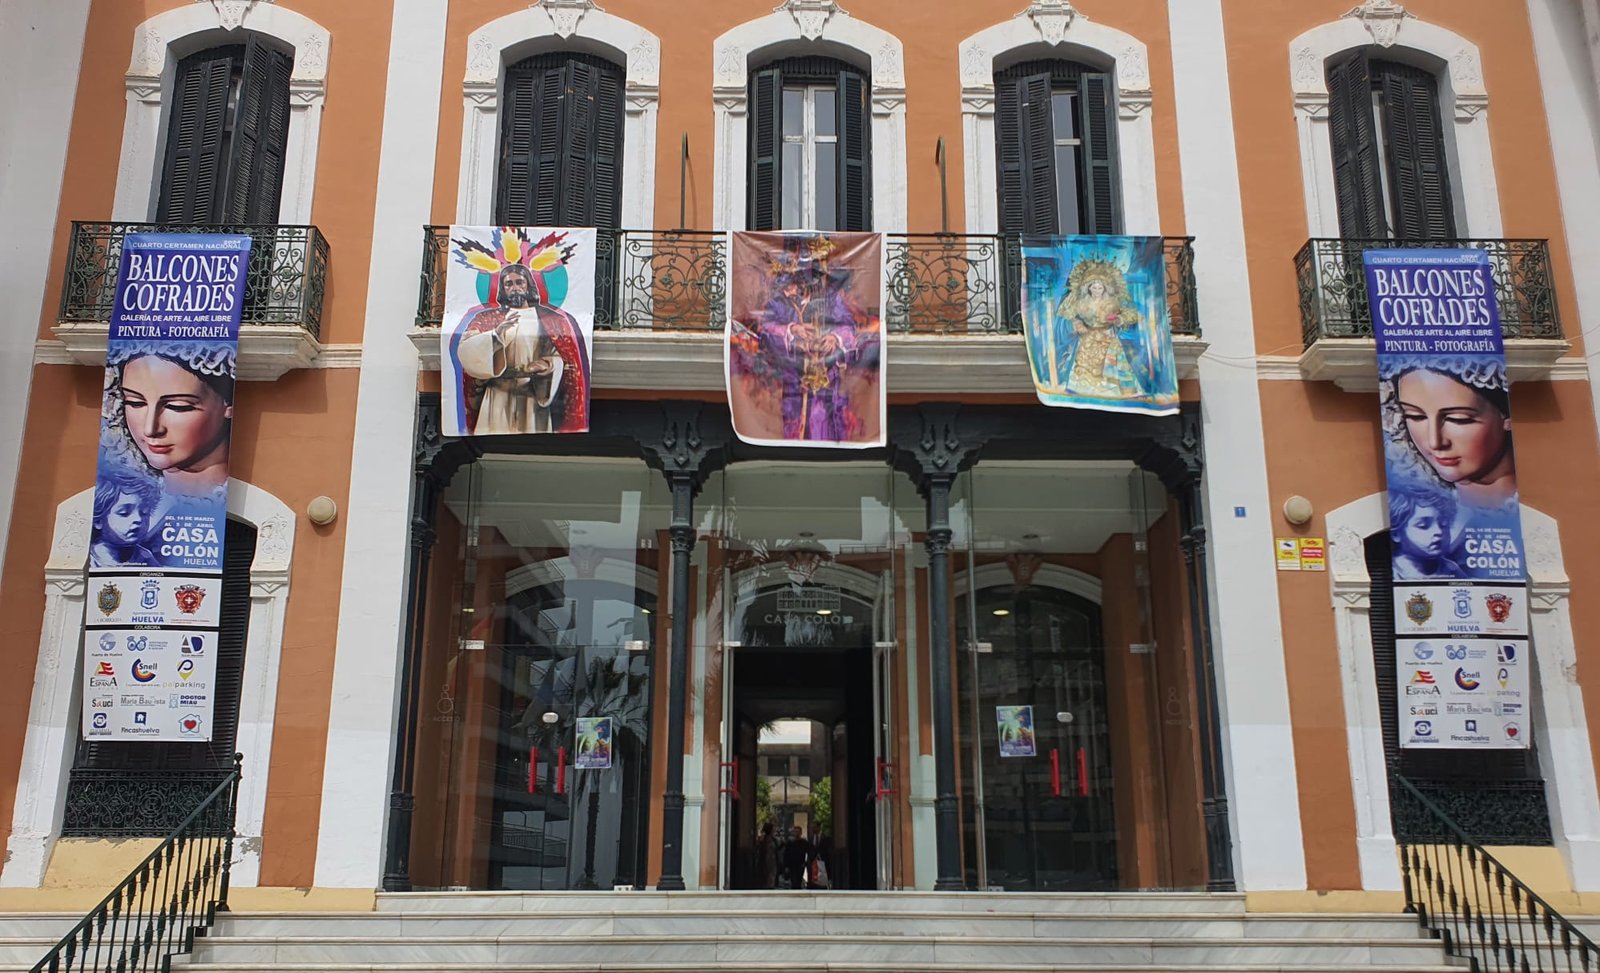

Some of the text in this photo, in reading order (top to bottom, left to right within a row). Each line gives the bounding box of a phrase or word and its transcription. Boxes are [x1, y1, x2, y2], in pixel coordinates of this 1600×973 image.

[126, 254, 239, 282] BALCONES
[1374, 269, 1485, 296] BALCONES
[123, 283, 235, 312] COFRADES
[121, 314, 151, 322] GALERÍA
[1380, 298, 1490, 326] COFRADES
[118, 326, 160, 337] PINTURA
[168, 324, 229, 337] FOTOGRAFÍA
[1383, 328, 1412, 336] GALERÍA
[1385, 340, 1428, 351] PINTURA
[1434, 339, 1495, 352] FOTOGRAFÍA
[162, 527, 218, 543] CASA
[160, 544, 218, 558] COLÓN
[1465, 539, 1518, 554] CASA
[1466, 555, 1520, 568] COLÓN
[92, 699, 113, 707] Sauci
